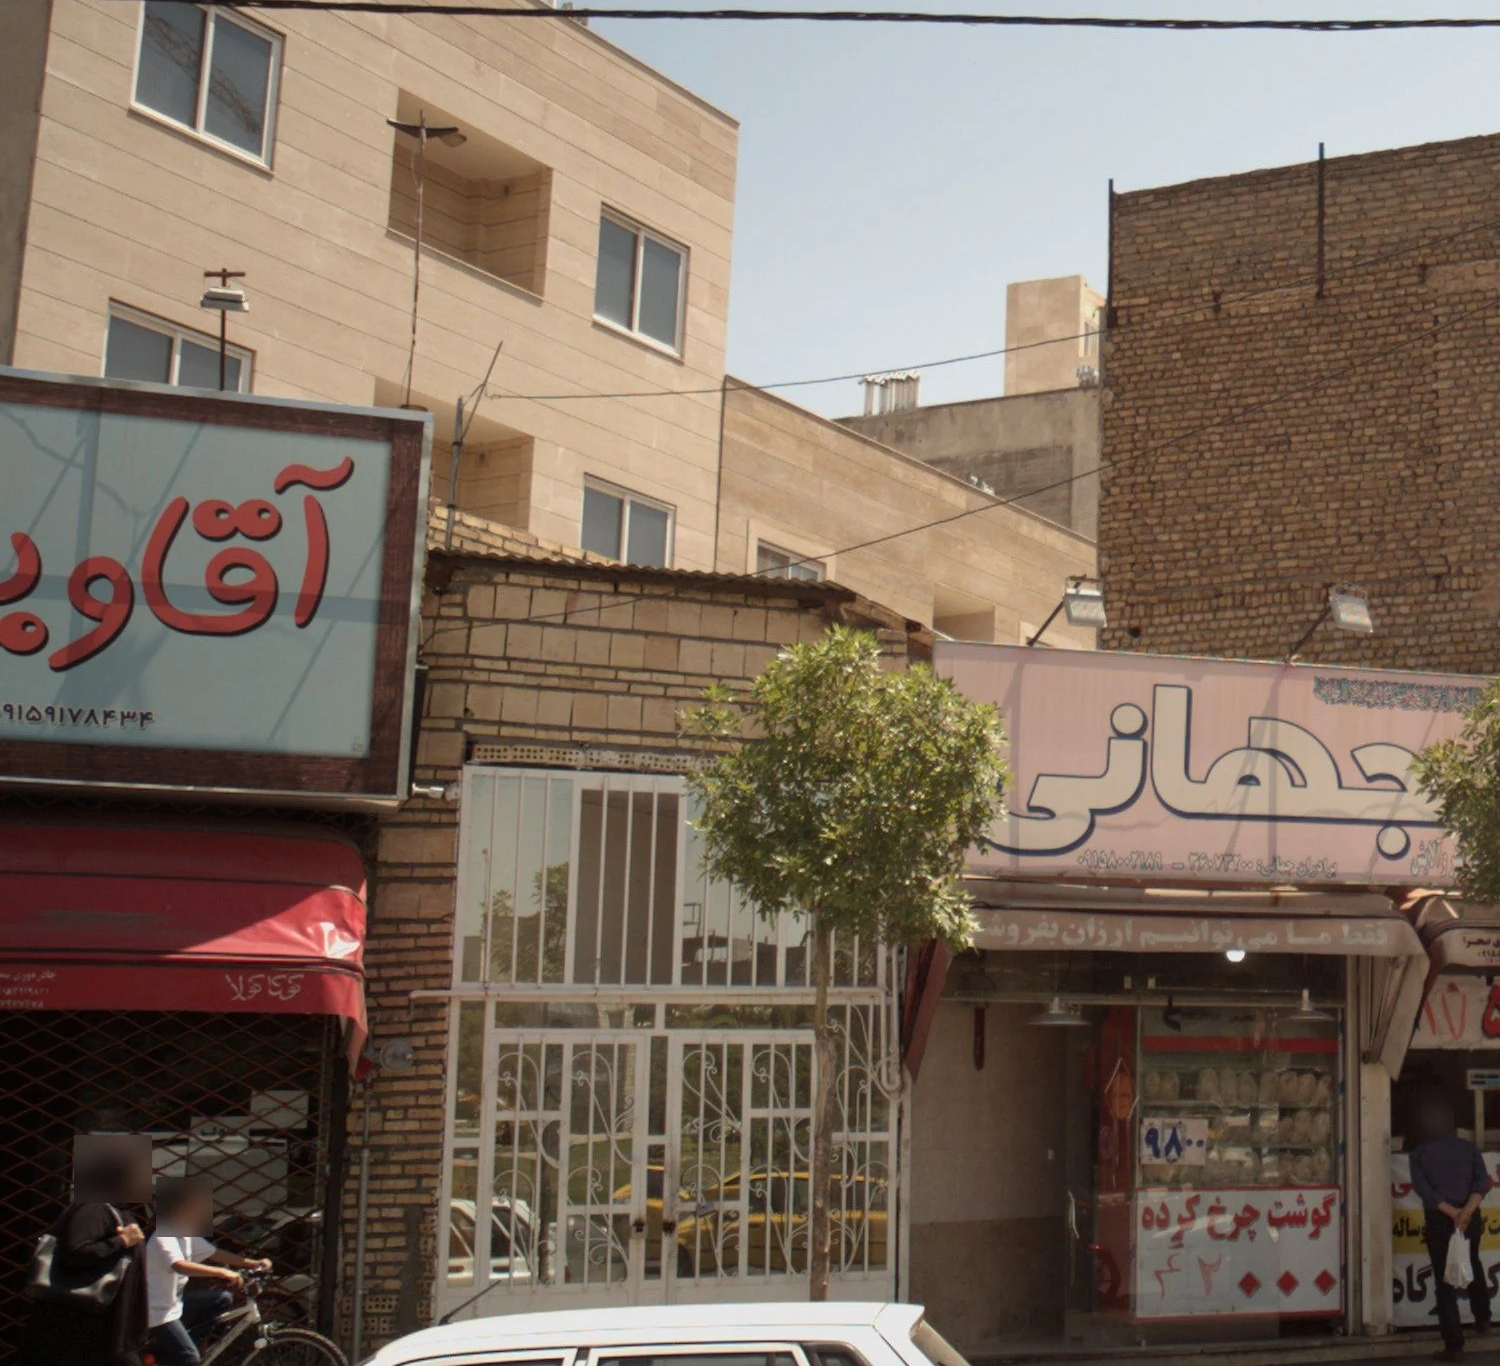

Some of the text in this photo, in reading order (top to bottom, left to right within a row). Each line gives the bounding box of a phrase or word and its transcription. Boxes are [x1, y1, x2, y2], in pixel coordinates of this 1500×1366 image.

[0, 702, 155, 730] ۹۱۵۹۱۷۸۴۳۴
[984, 685, 1455, 859] جهانی
[980, 916, 1059, 946] بفروش
[1145, 1126, 1205, 1161] ۹۸۰۰
[1141, 1192, 1337, 1244] گوشت چرخ کرده
